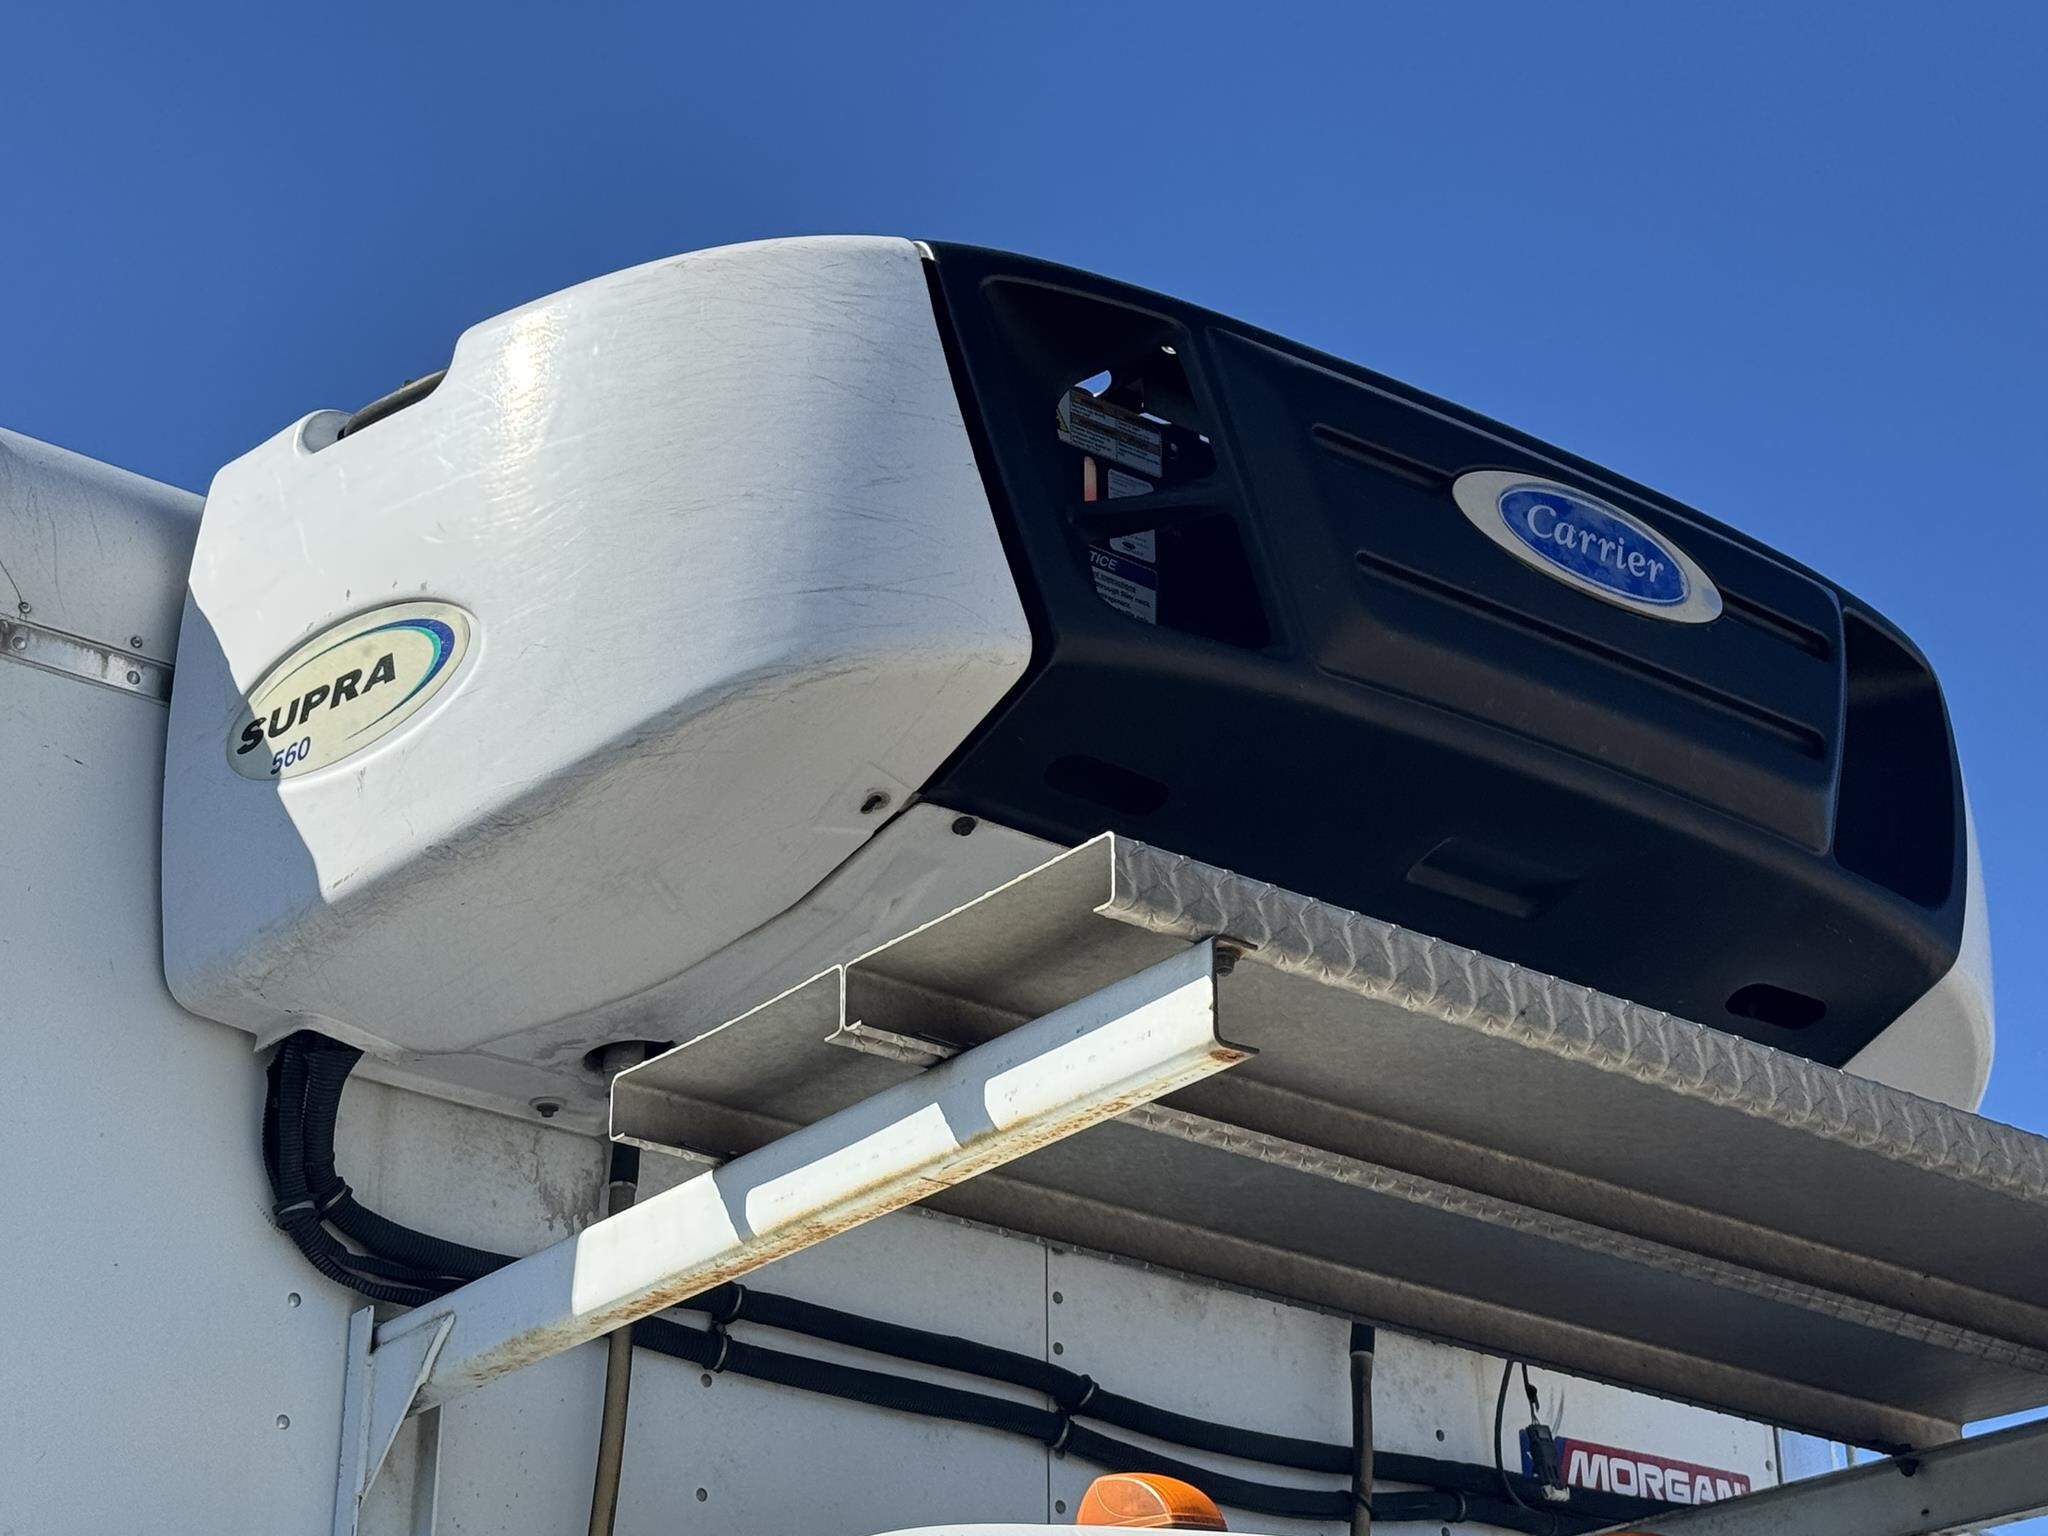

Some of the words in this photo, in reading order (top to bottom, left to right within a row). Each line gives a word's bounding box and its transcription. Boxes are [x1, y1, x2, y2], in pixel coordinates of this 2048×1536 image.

[1089, 549, 1118, 571] TICE
[1527, 504, 1664, 582] Carrier
[236, 652, 396, 755] SUPRA
[270, 736, 311, 775] 560
